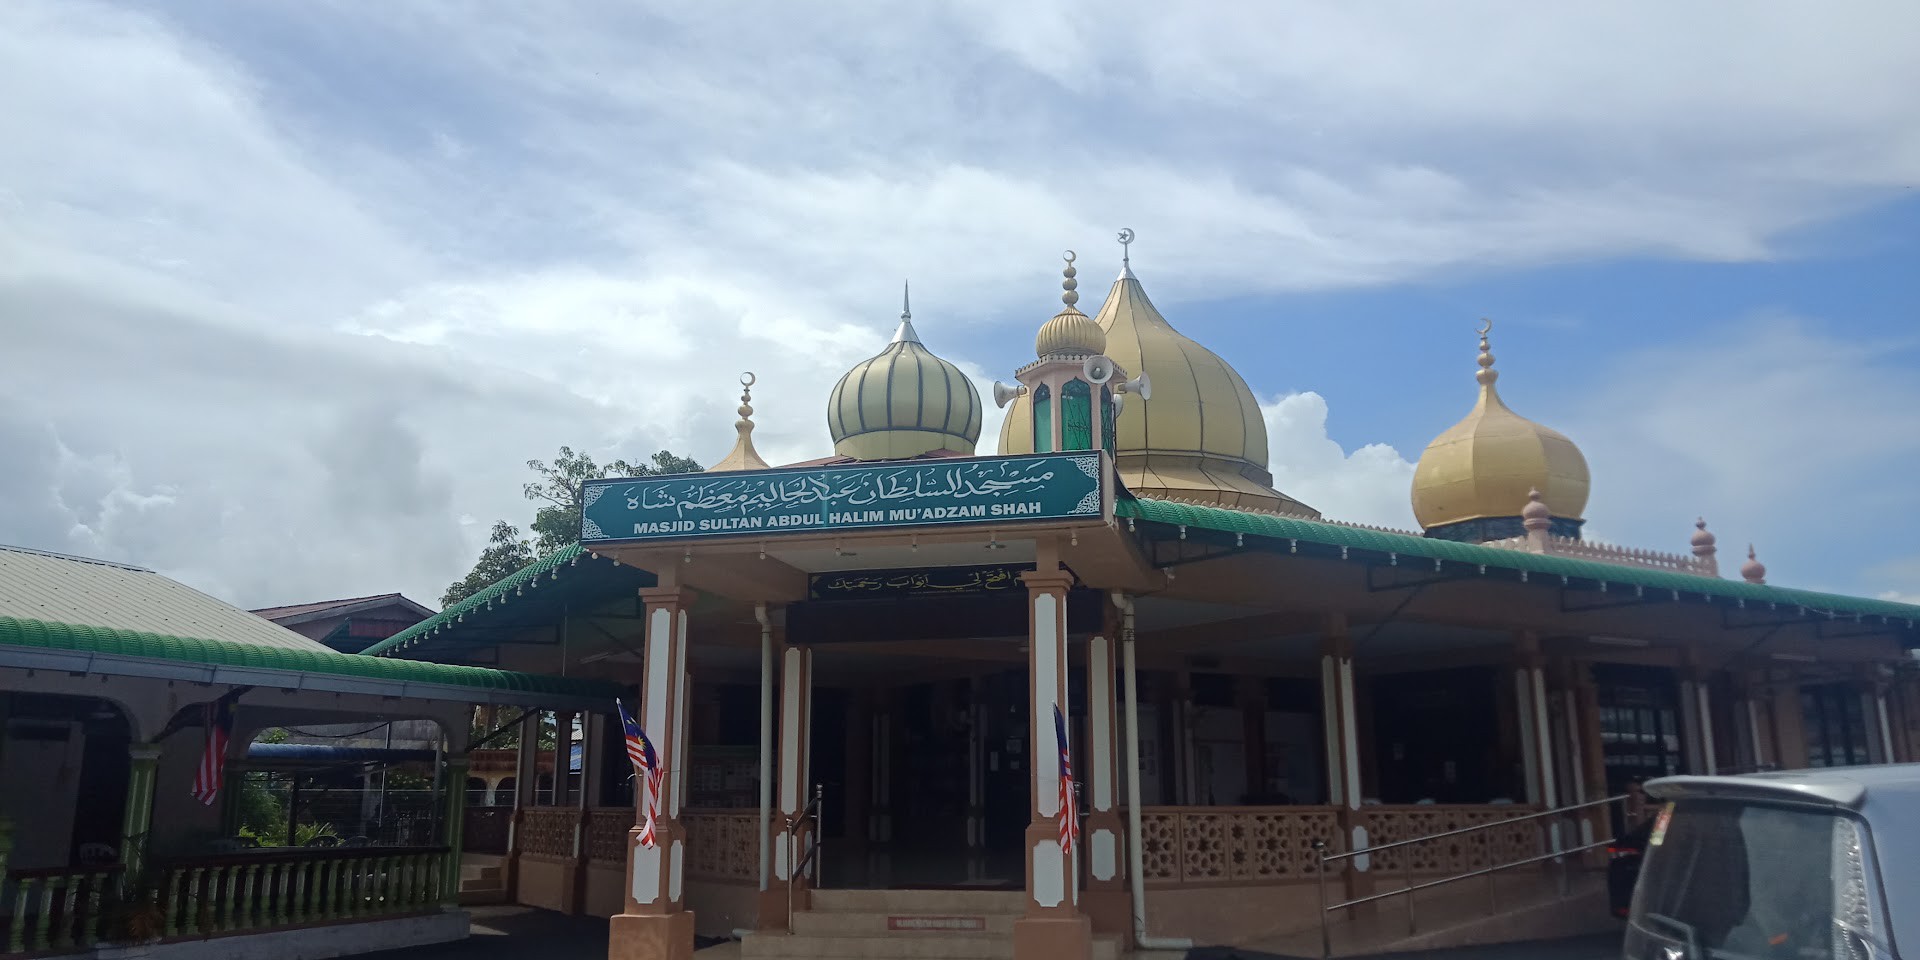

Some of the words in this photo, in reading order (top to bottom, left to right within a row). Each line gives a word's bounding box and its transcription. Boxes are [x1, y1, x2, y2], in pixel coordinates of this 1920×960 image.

[624, 484, 676, 510] شاه
[848, 467, 961, 505] السلطان
[954, 459, 1054, 498] مسجد
[633, 520, 695, 535] MASJID
[699, 516, 762, 531] SULTAN
[767, 513, 825, 528] ABDUL
[829, 509, 884, 524] HALIM
[991, 501, 1041, 515] SHAH
[677, 480, 749, 519] معظم
